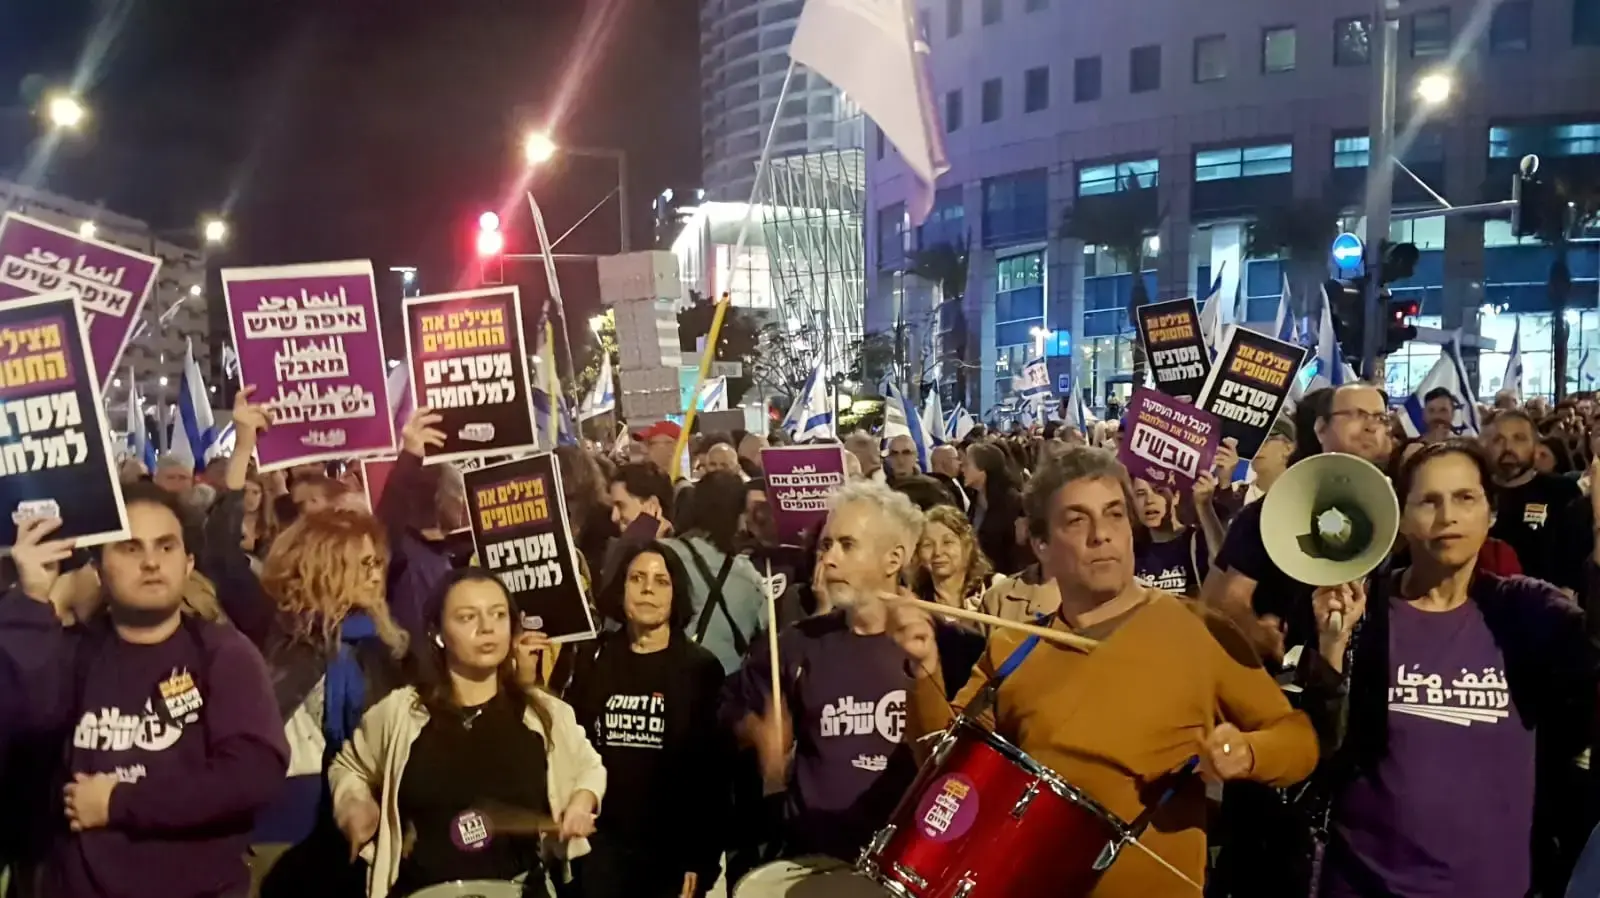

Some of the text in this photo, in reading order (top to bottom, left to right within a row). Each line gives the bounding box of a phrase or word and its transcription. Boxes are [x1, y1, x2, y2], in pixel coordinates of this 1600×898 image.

[6, 262, 61, 289] שיש
[247, 312, 362, 332] איפה שיש
[421, 308, 503, 332] מצילים את
[423, 325, 505, 353] החטופים
[1148, 325, 1194, 343] החטופים
[1153, 345, 1200, 366] מסרבים
[1236, 344, 1292, 371] מצילים את
[280, 358, 345, 381] מאבק
[423, 352, 513, 385] מסרבים
[1157, 361, 1204, 382] למלחמה
[1231, 356, 1288, 386] החטופים
[426, 378, 516, 409] למלחמה
[1219, 379, 1279, 411] מסרבים
[342, 399, 369, 413] יש
[1142, 398, 1173, 419] העסקה
[1172, 411, 1188, 424] את
[1211, 398, 1270, 429] למלחמה
[1187, 415, 1211, 434] לקבל
[1137, 429, 1194, 472] עכשיו
[772, 475, 838, 484] מחזירים את
[477, 478, 544, 507] מצילים את
[480, 498, 548, 531] החטופים
[485, 532, 558, 569] מסרבים
[501, 560, 563, 593] למלחמ
[1452, 667, 1508, 690] نقف
[1426, 688, 1509, 708] עומדים
[605, 712, 646, 730] כיבוש
[820, 714, 874, 736] שלום
[73, 724, 135, 750] שלום
[928, 814, 947, 829] חיים
